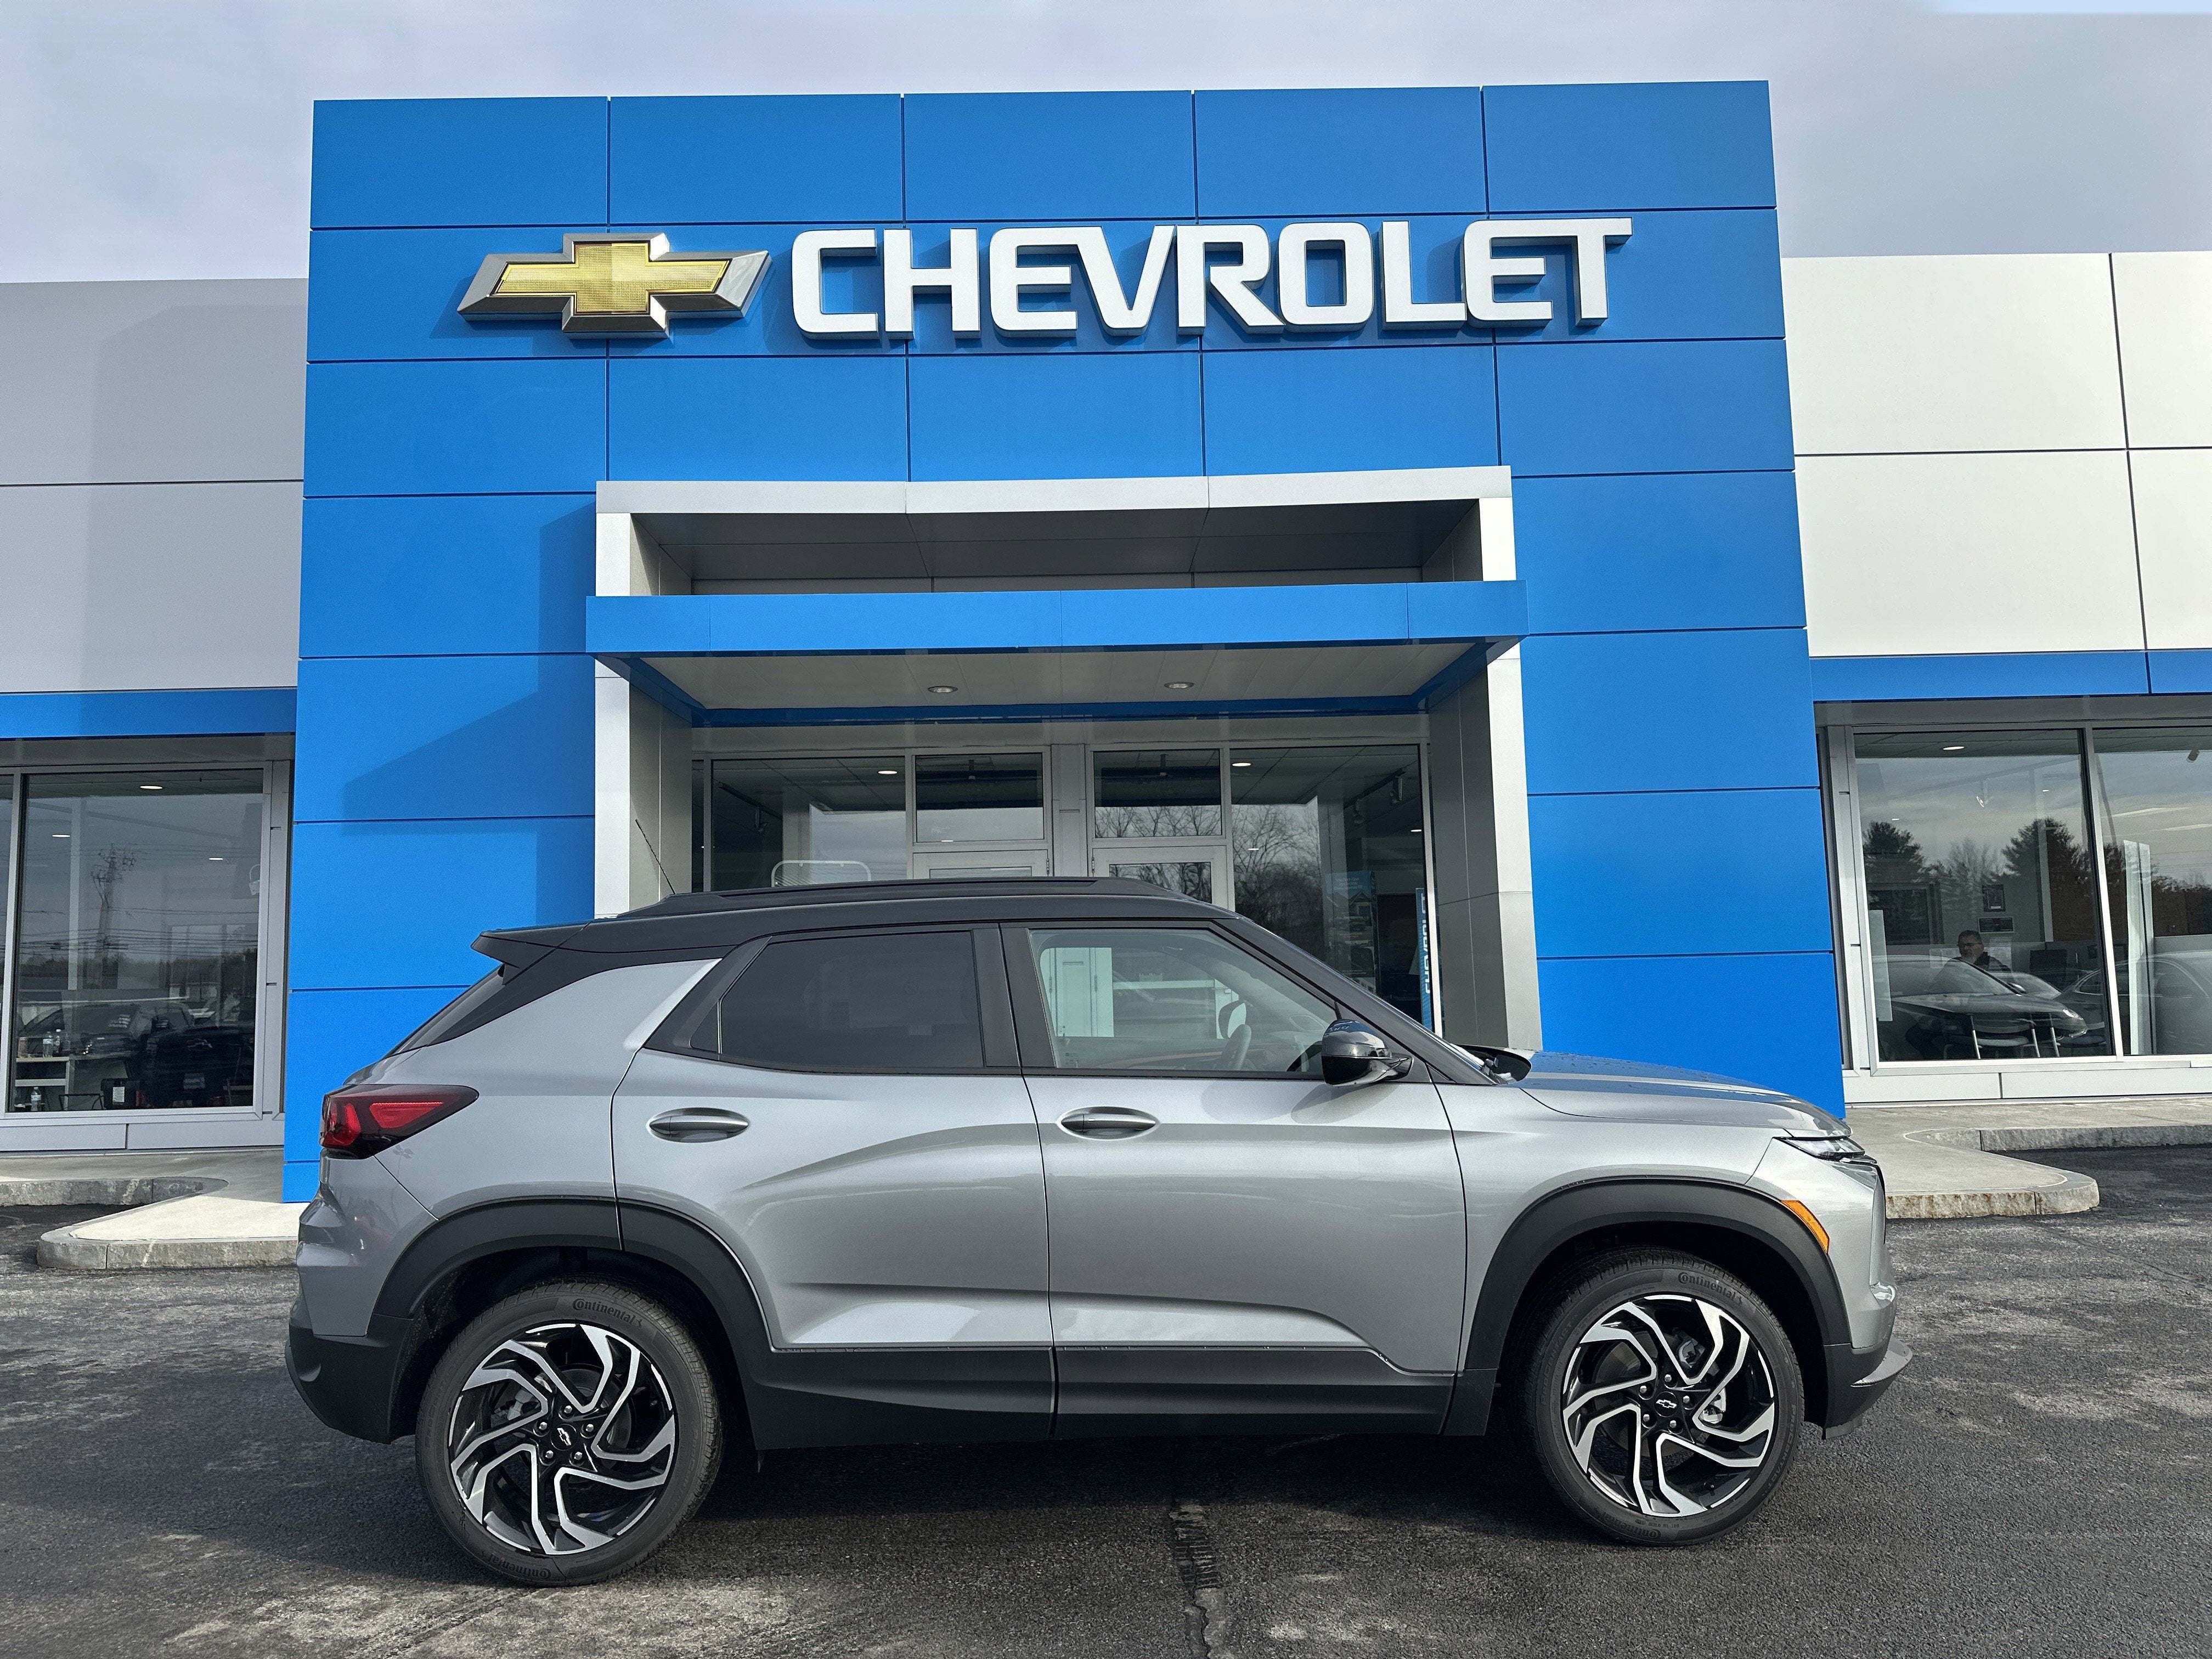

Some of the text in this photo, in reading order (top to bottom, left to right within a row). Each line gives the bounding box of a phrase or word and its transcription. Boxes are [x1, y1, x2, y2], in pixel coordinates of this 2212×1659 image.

[792, 217, 1633, 338] CHEVROLET
[1678, 1272, 1736, 1301] Continental
[572, 1298, 636, 1325] Continental
[487, 1554, 552, 1579] Continental
